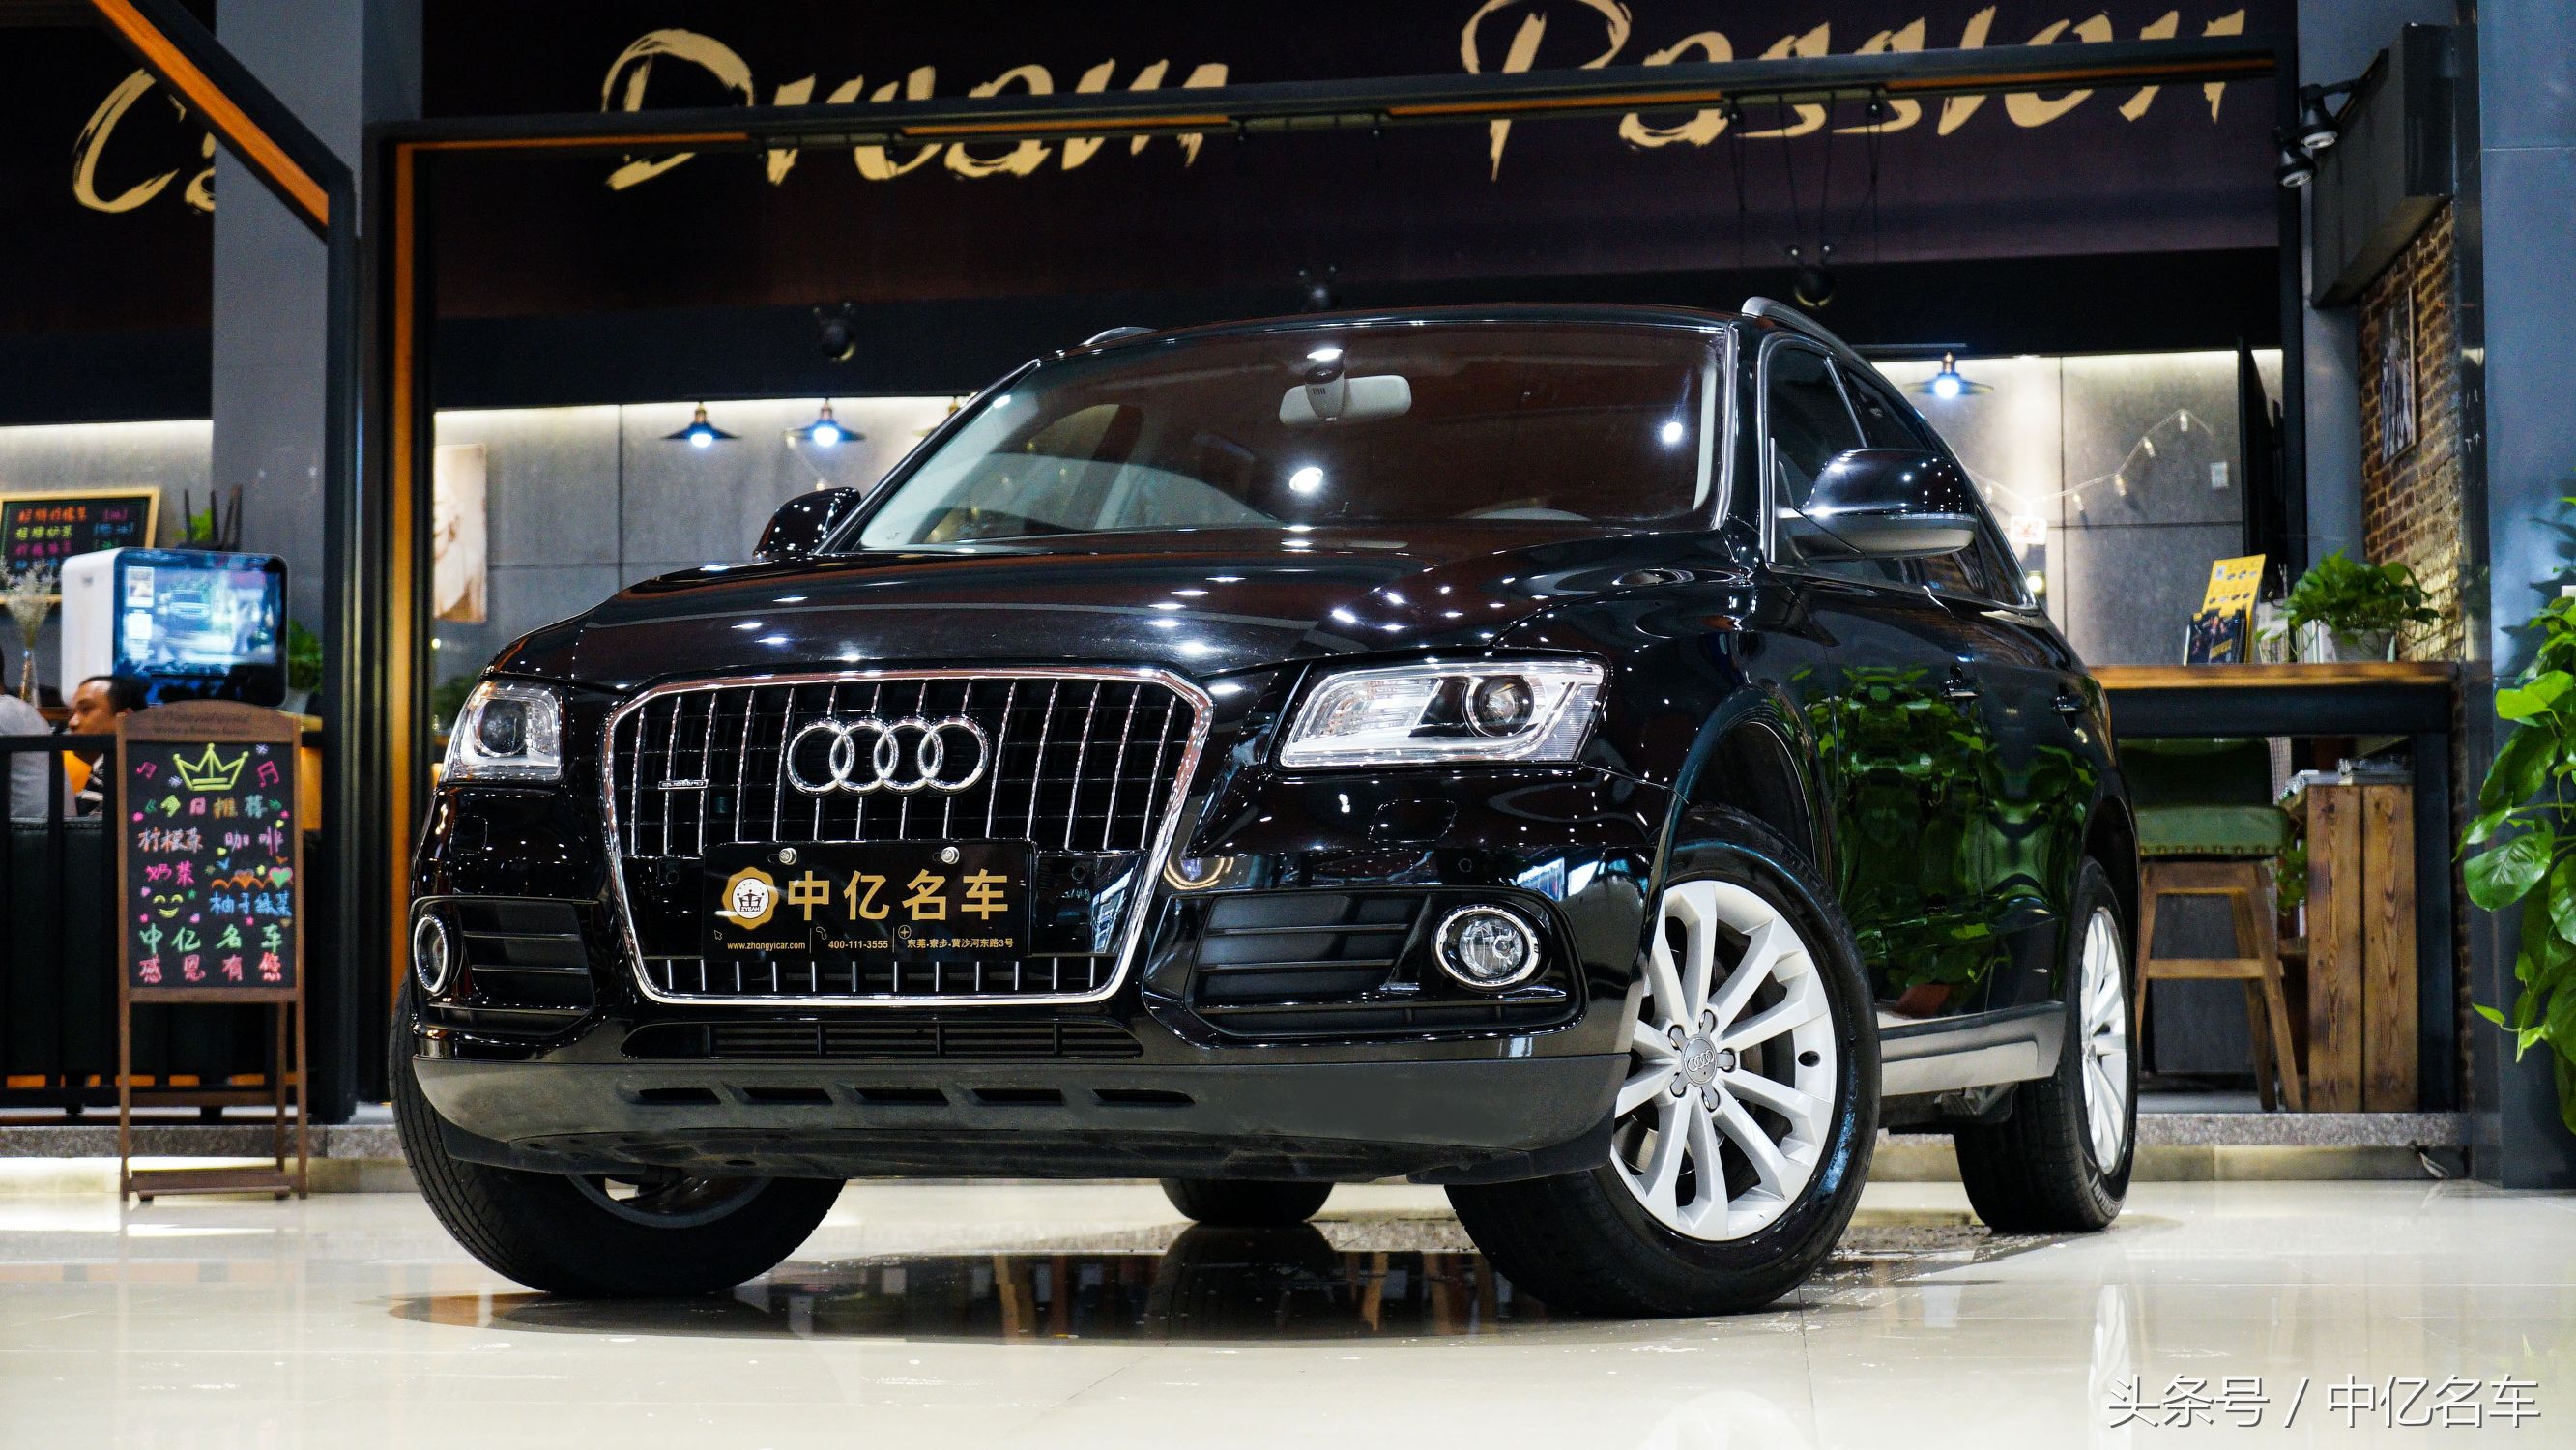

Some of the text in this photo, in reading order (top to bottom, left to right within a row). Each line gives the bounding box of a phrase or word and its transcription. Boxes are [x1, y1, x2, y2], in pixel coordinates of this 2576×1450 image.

[224, 826, 284, 856] 咖啡
[146, 860, 194, 887] 奶茶
[788, 868, 1008, 920] 中亿名车
[139, 923, 283, 954] 中亿名车
[727, 941, 806, 952] www.zhongyicar.com
[828, 939, 888, 950] 400-111-3555
[138, 952, 281, 984] 感恩有您
